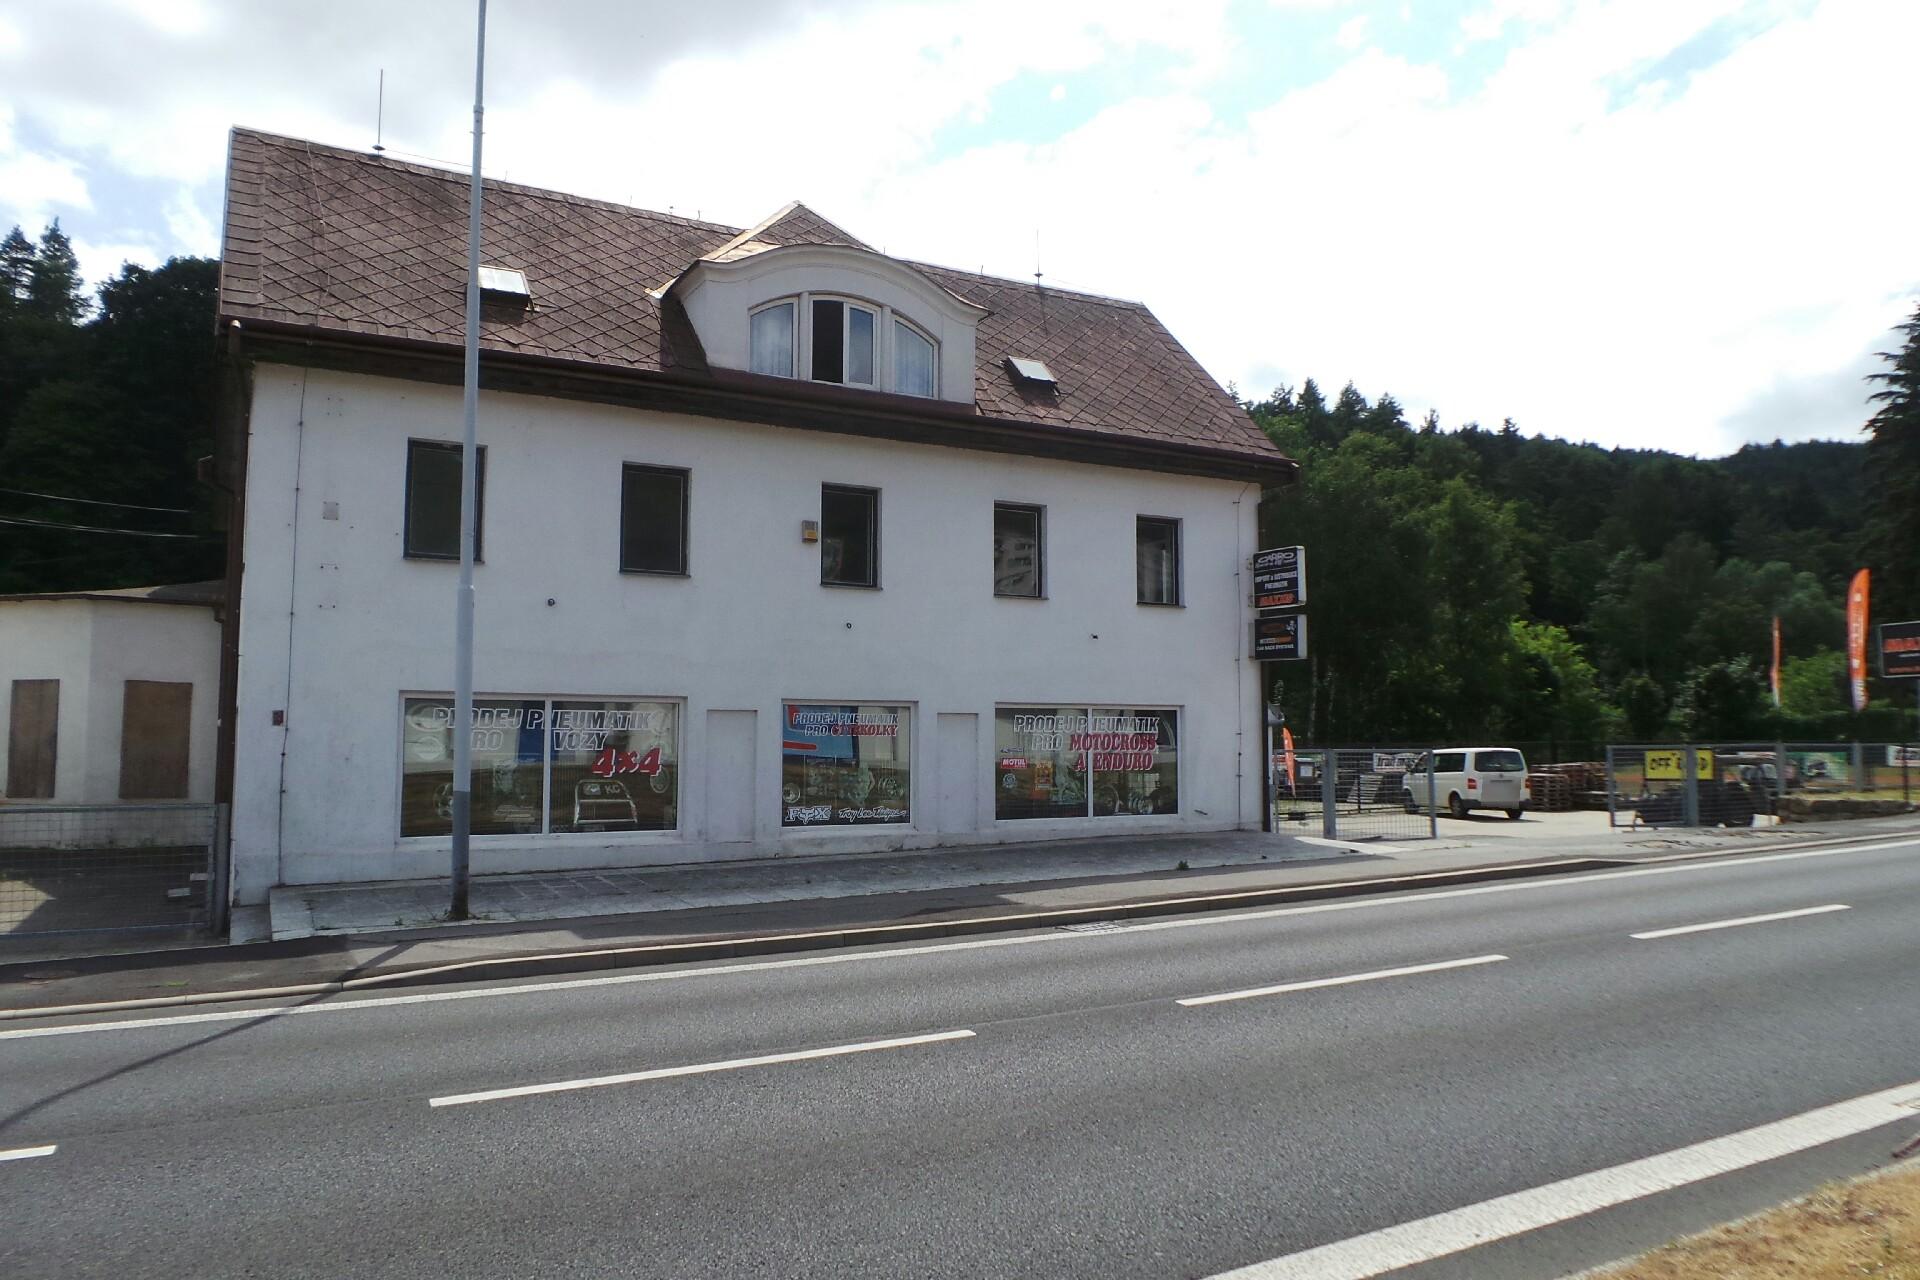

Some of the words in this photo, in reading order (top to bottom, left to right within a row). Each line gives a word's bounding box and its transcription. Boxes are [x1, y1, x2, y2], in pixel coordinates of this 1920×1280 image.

[805, 725, 828, 736] PRO
[1014, 715, 1072, 733] PRODEJ
[471, 730, 503, 750] RO
[553, 730, 608, 751] VOZY
[1033, 734, 1062, 751] PRO
[1070, 734, 1157, 751] MOTOCROSS
[1002, 758, 1027, 766] MOTUL
[1093, 753, 1153, 772] ENDURO
